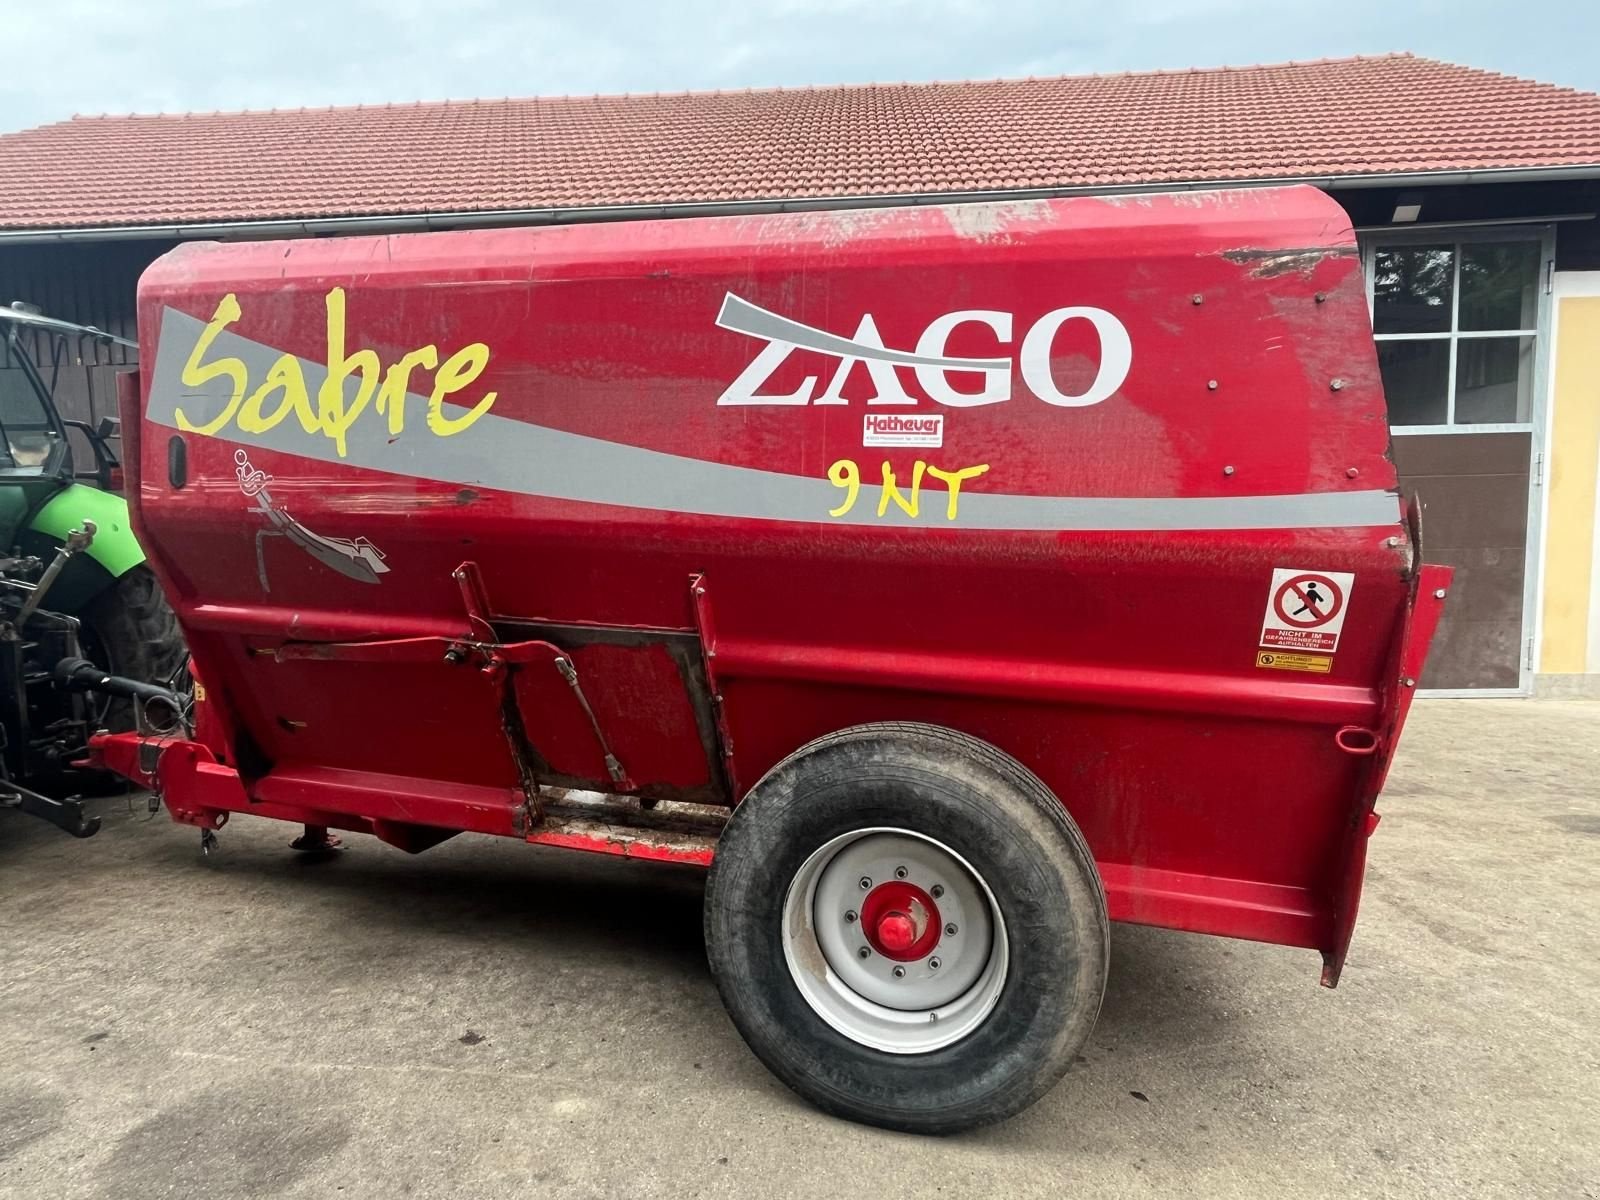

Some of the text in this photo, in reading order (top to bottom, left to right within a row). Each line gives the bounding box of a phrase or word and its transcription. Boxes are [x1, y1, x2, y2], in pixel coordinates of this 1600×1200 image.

[175, 287, 498, 457] Sabre
[715, 291, 1133, 407] ZAGO
[1265, 635, 1334, 645] GEFAHRENBEREICH
[1277, 640, 1320, 648] AUFHALTEN
